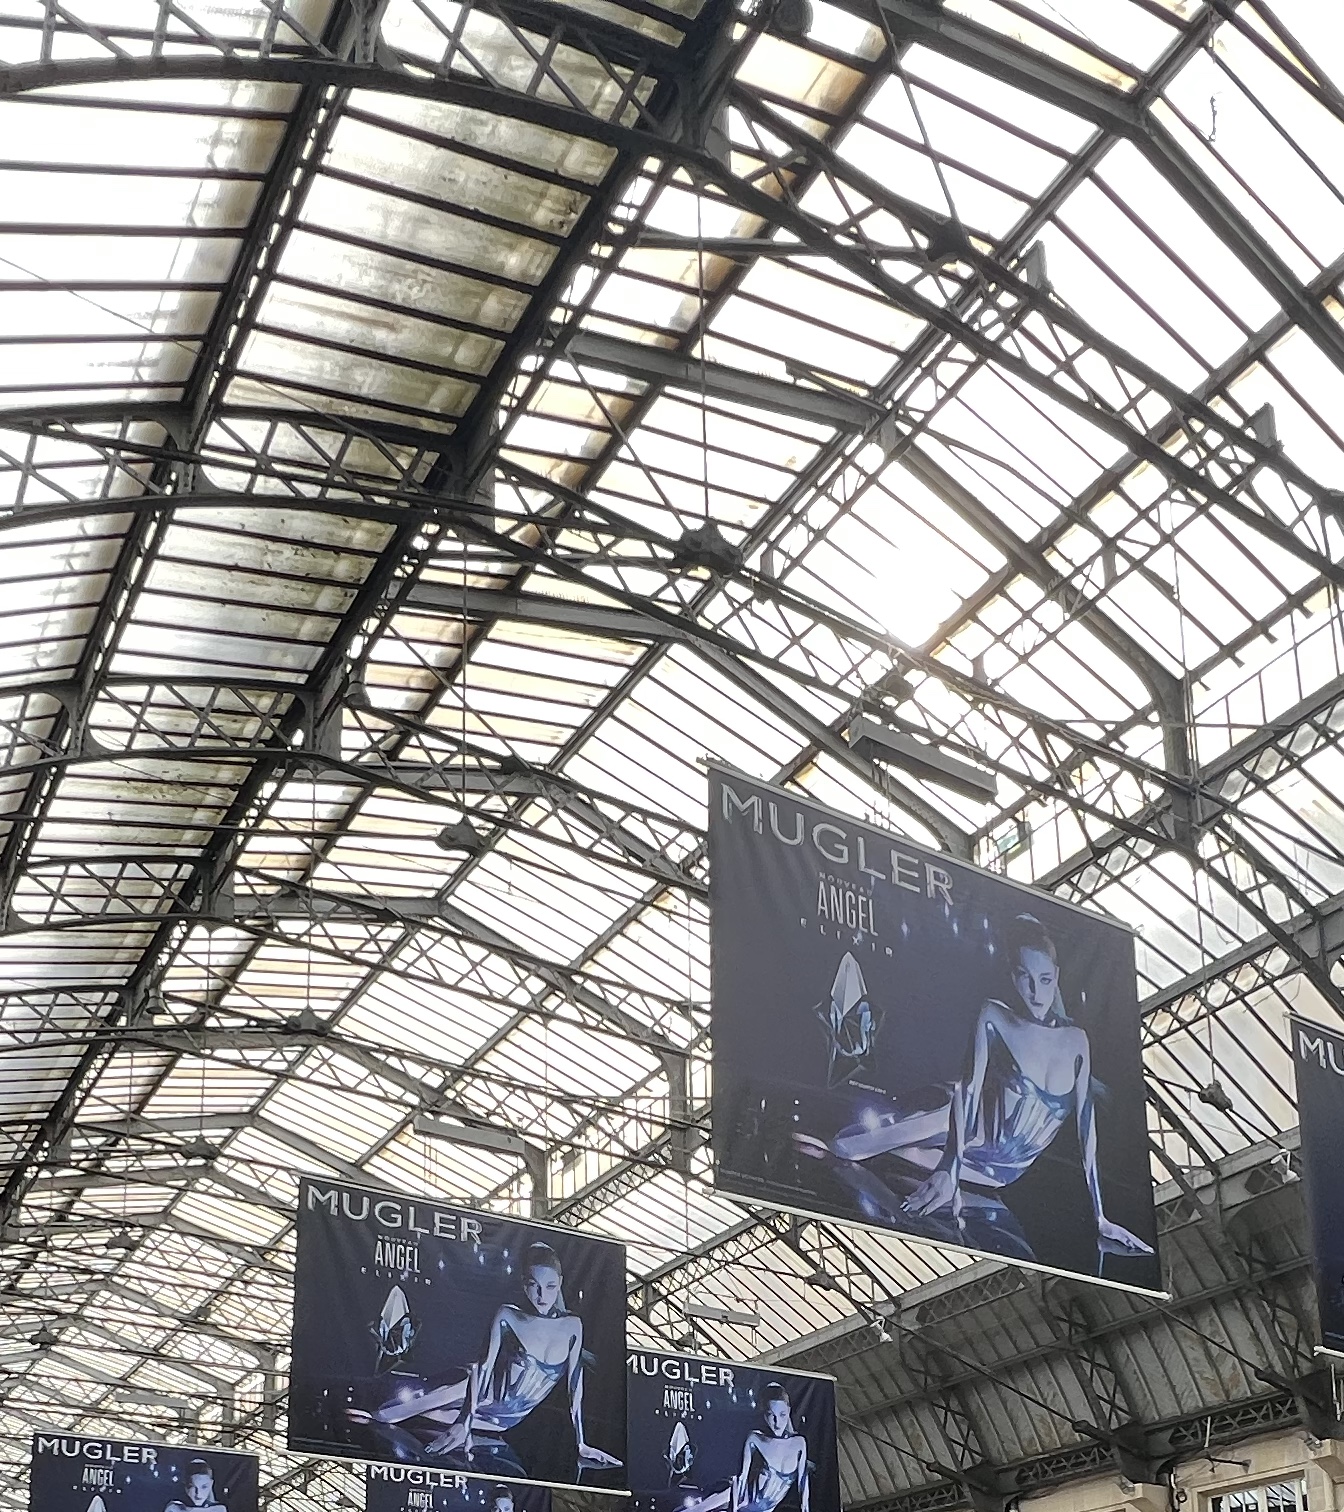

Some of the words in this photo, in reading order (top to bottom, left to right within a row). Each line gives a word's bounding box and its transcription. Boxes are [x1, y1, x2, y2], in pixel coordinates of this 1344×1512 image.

[721, 783, 954, 906] MUGLER
[818, 881, 878, 936] ANGEL
[800, 917, 893, 957] ELIXIR
[307, 1184, 483, 1245] MUGLER
[374, 1240, 421, 1274] ANGEL
[663, 1389, 695, 1412] ANGEL
[38, 1437, 157, 1464] MUGLER
[82, 1467, 115, 1487] ANGEL
[370, 1465, 468, 1488] MUGLER
